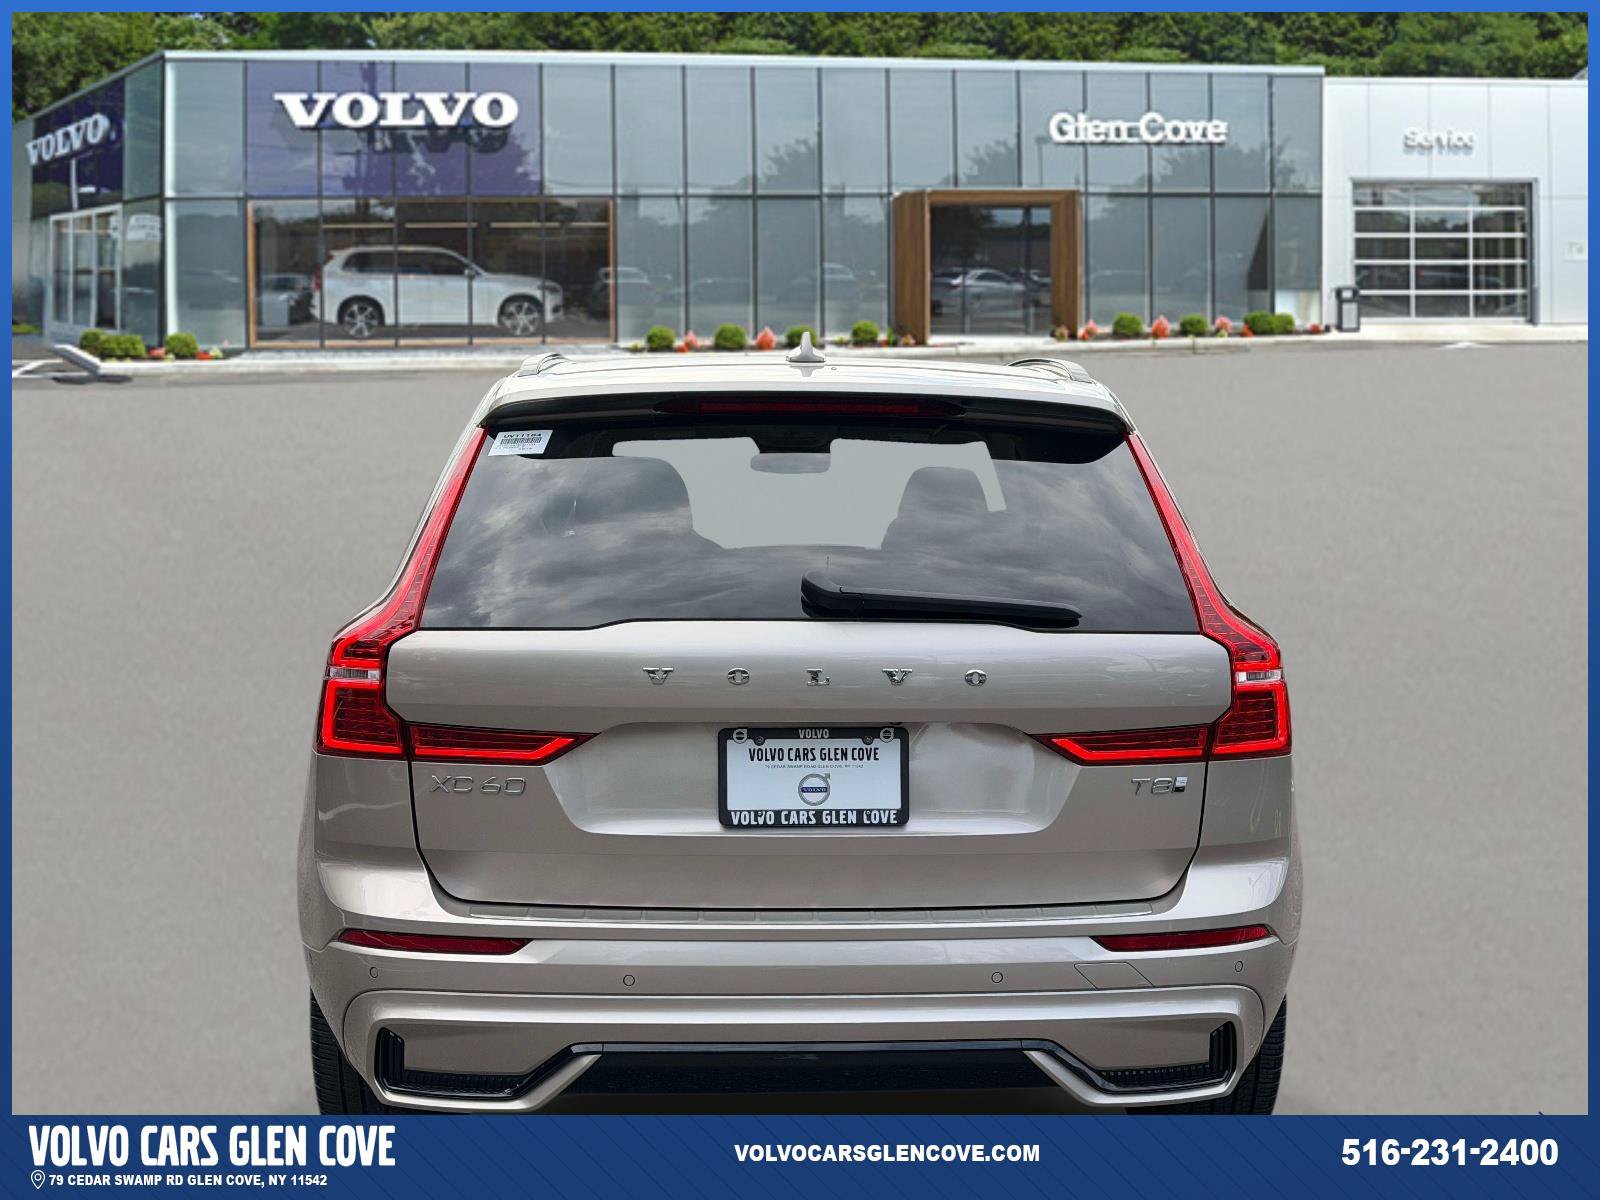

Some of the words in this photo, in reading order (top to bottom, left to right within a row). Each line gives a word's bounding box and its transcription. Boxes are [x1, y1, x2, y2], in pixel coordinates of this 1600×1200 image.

[275, 92, 519, 127] VOLVO
[1049, 112, 1129, 143] Glen
[1139, 112, 1227, 143] Cove
[25, 113, 110, 165] VOLVO
[1402, 128, 1474, 151] Service
[643, 667, 988, 686] VOLVO
[799, 729, 830, 739] VOLVO
[749, 748, 784, 762] VOLVO
[787, 748, 815, 762] CARS
[820, 748, 848, 762] GLEN
[852, 747, 880, 761] COVE
[1131, 777, 1172, 795] T8
[731, 811, 774, 825] VOLVO
[781, 810, 816, 825] CARS
[822, 810, 857, 824] GLEN
[863, 810, 898, 824] COVE
